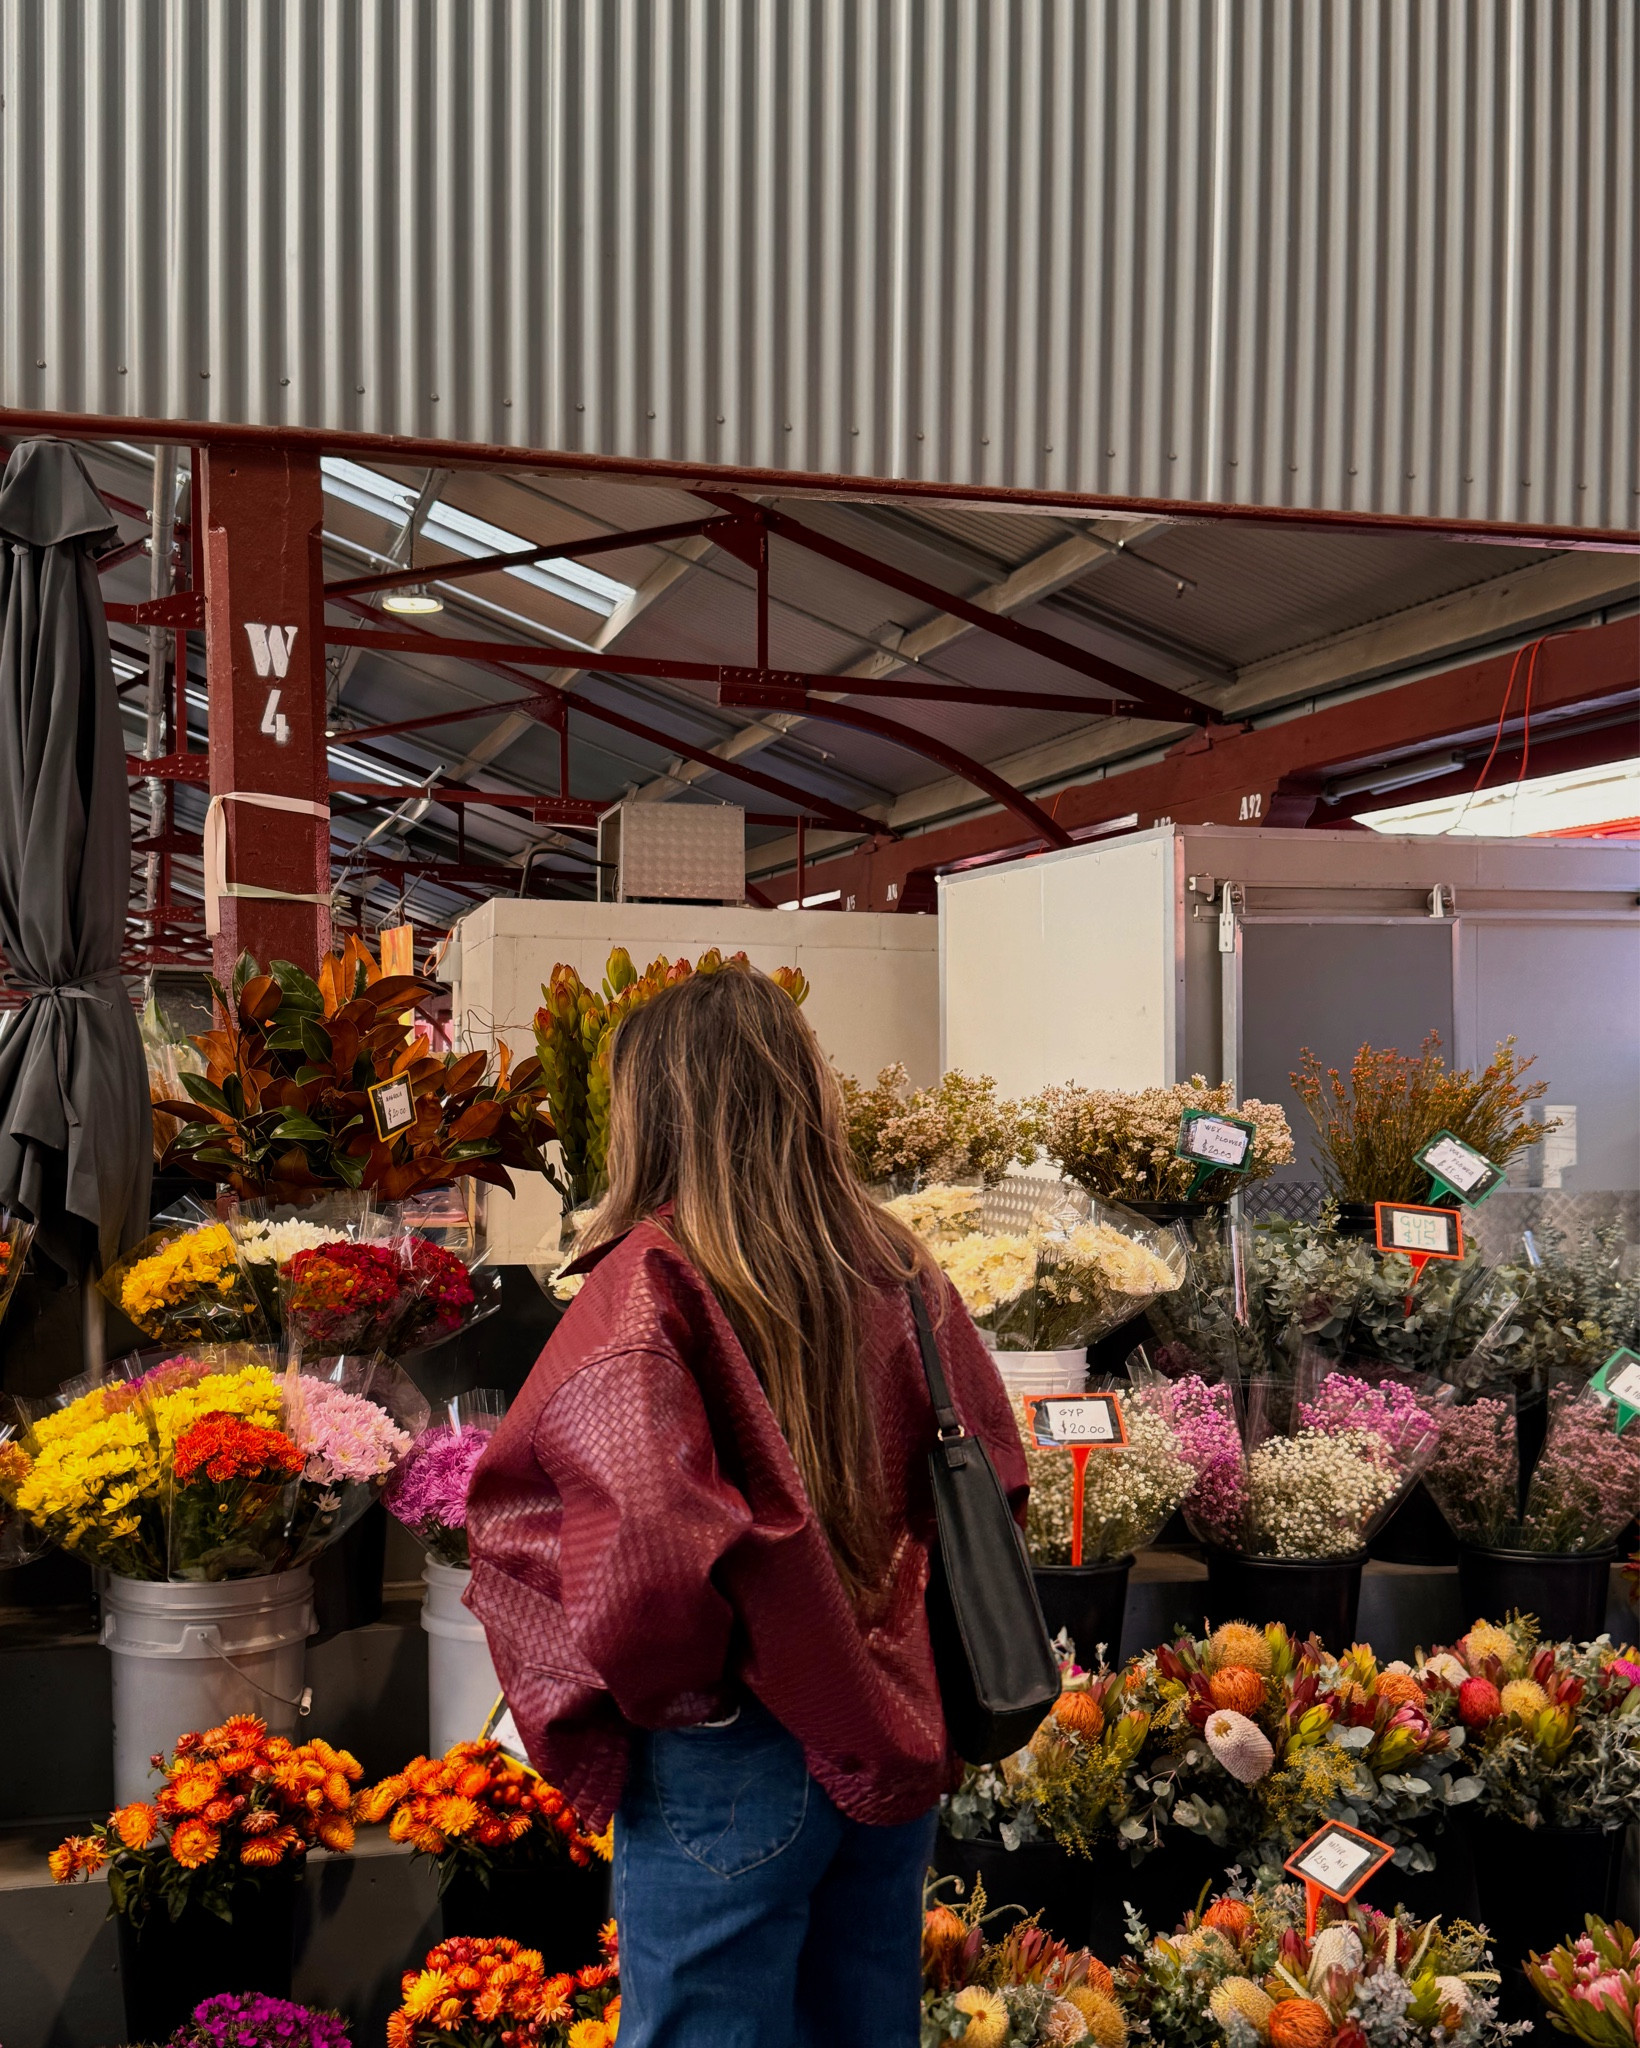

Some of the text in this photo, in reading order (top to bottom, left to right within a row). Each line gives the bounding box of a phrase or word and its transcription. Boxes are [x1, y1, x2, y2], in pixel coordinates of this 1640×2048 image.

[244, 623, 298, 678] W
[261, 689, 290, 742] 4
[1239, 793, 1262, 821] A92
[1201, 1139, 1232, 1159] $20.00
[1215, 1134, 1244, 1148] FLOWER
[1400, 1215, 1436, 1232] GUM
[1403, 1229, 1436, 1246] $15
[1059, 1408, 1084, 1417] GYP
[1058, 1420, 1106, 1435] $20.00
